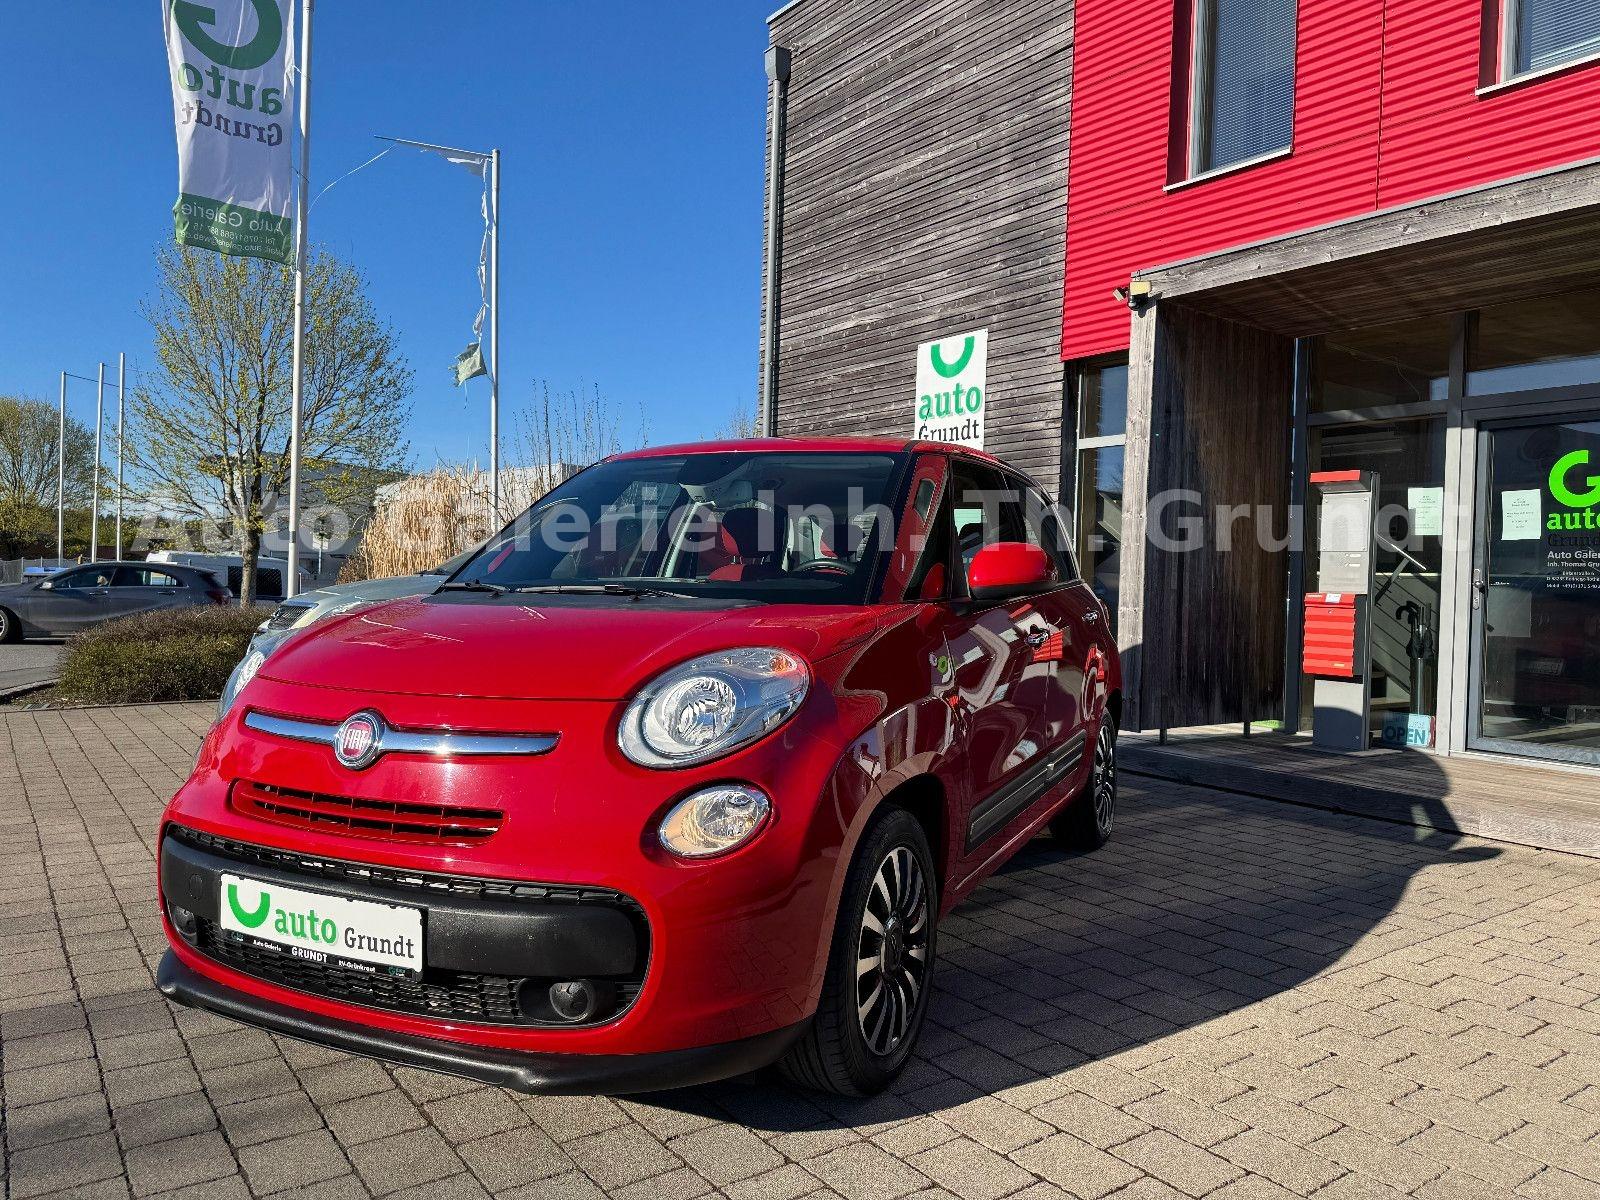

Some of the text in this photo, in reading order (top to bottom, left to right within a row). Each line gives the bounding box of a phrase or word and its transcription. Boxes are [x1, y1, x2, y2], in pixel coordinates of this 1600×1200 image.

[918, 383, 982, 420] auto
[918, 418, 980, 442] Grundt
[1547, 550, 1572, 559] Auto
[343, 728, 370, 749] FIAT
[1384, 725, 1426, 745] OPEN
[274, 908, 415, 959] auto Grundt
[291, 946, 328, 964] GRUNDT
